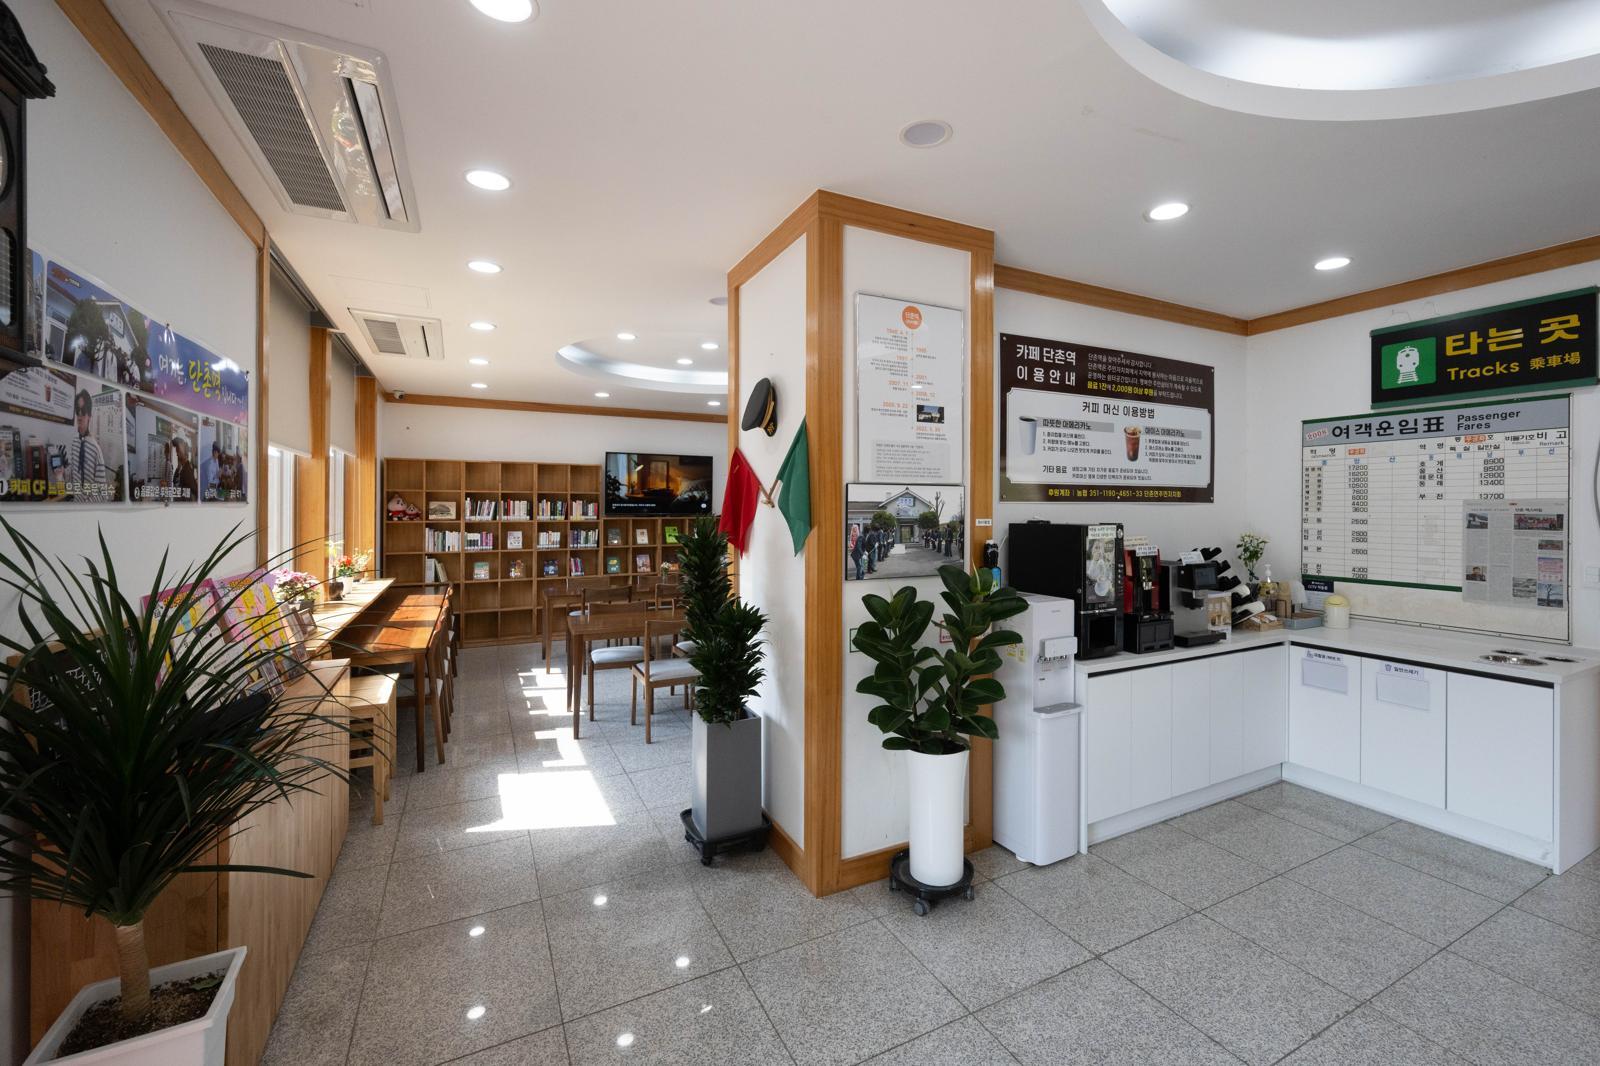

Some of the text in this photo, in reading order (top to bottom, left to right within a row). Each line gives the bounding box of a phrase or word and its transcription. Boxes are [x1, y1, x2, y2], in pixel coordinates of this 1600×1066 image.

[1445, 313, 1581, 357] 타는 곳
[1016, 344, 1076, 366] 카페 단촌역
[189, 360, 220, 401] 단촌역
[1447, 361, 1520, 381] Tracks
[1082, 401, 1155, 419] 커피 머신 이용방법
[1457, 410, 1521, 423] Passenger
[1042, 418, 1062, 428] 따뜻한
[1332, 416, 1444, 440] 여객운임표
[1457, 422, 1491, 431] Fares
[1042, 464, 1068, 474] 기타 음료
